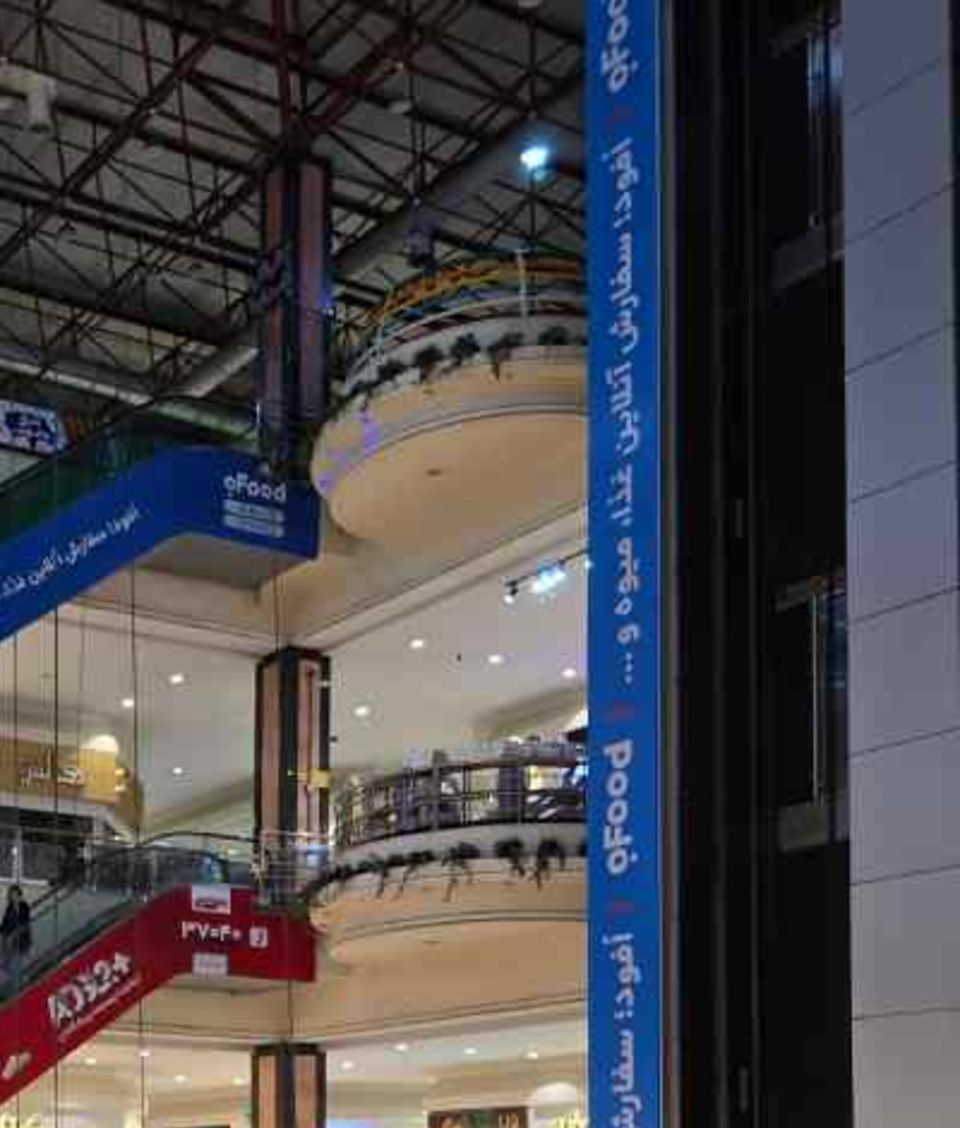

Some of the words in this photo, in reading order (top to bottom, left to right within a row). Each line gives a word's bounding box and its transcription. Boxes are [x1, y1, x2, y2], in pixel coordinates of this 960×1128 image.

[608, 231, 640, 354] سفارش
[605, 360, 640, 458] آنلاین
[615, 537, 640, 616] میوه
